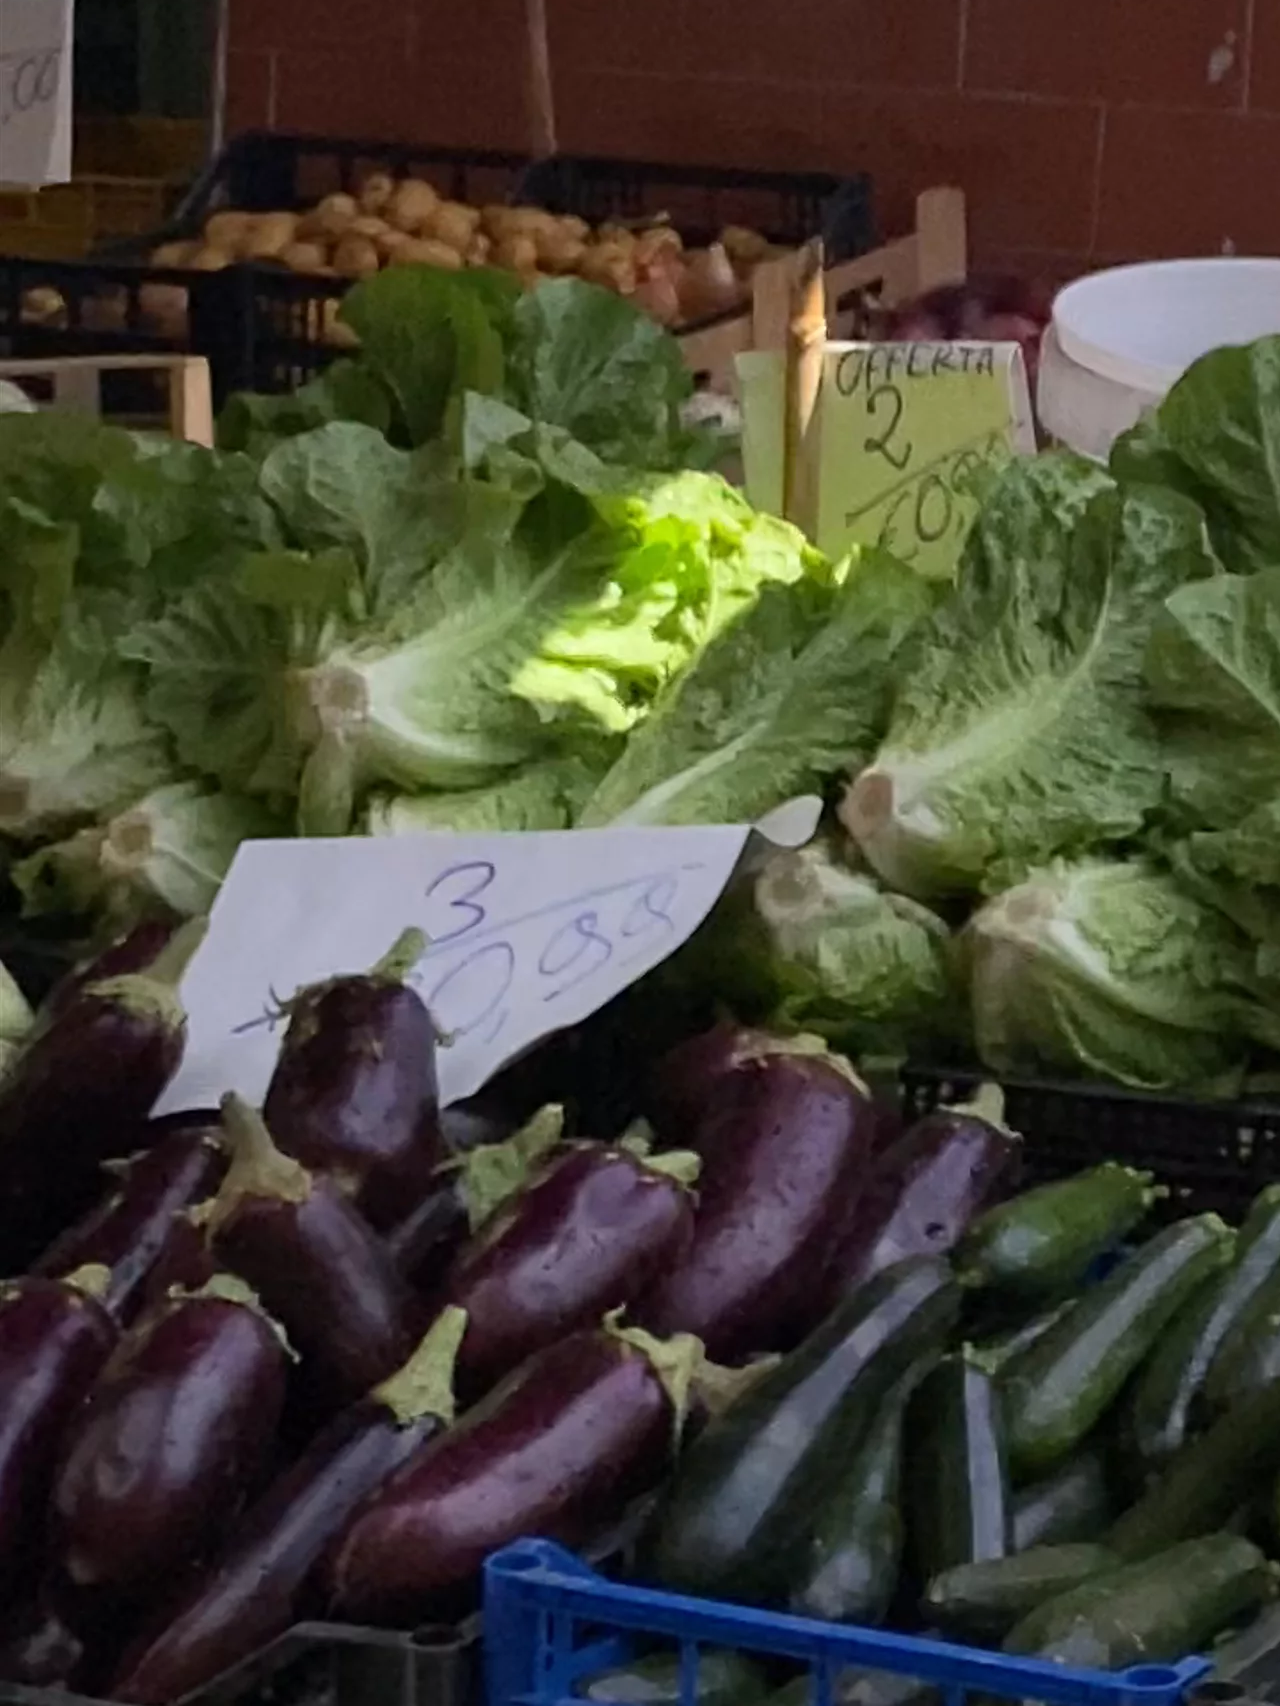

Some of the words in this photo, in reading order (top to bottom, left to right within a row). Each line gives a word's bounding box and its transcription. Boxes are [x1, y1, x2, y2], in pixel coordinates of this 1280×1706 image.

[834, 343, 995, 397] OFFERTA
[863, 384, 912, 470] 2
[424, 860, 496, 946] 3
